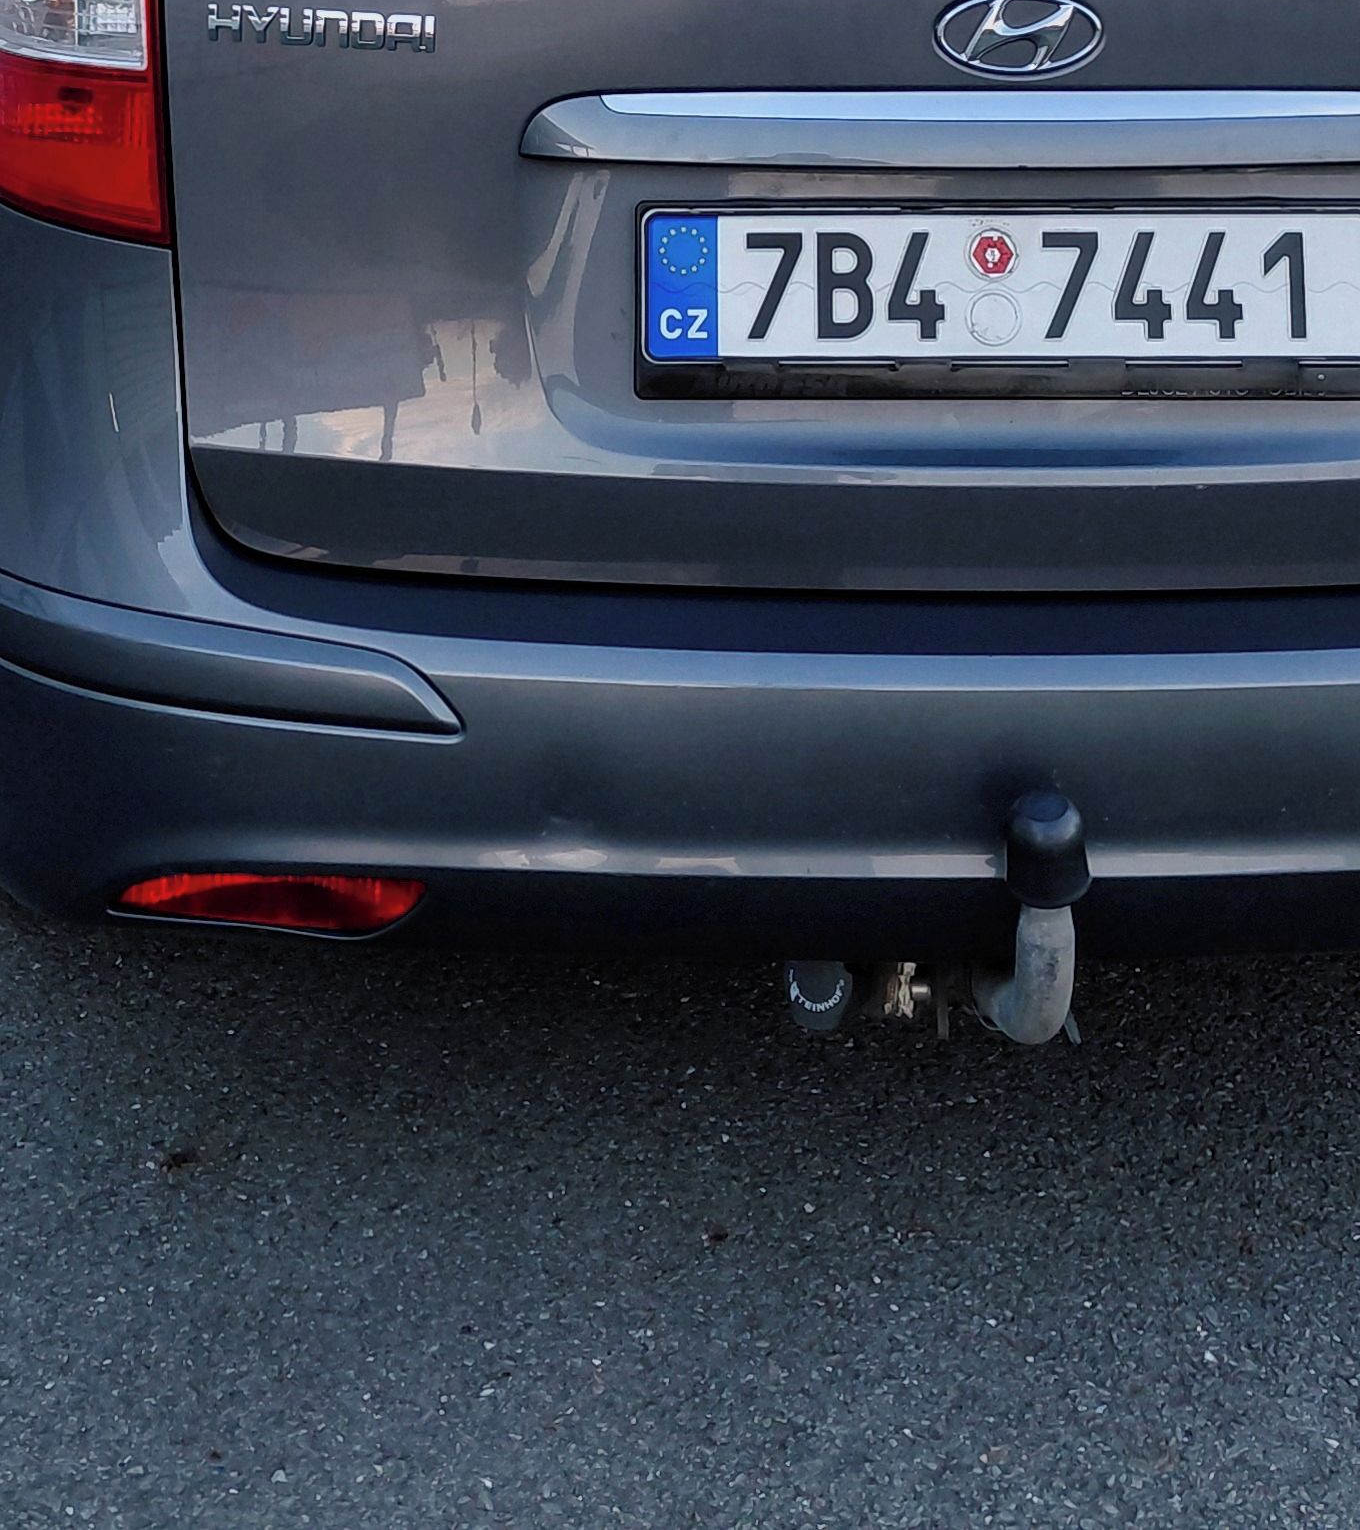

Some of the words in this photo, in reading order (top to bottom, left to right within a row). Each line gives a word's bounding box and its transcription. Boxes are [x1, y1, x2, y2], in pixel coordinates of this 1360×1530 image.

[207, 3, 437, 53] HYUNDAI
[745, 231, 946, 340] 7B4
[1040, 231, 1307, 340] 7441
[659, 308, 709, 339] CZ
